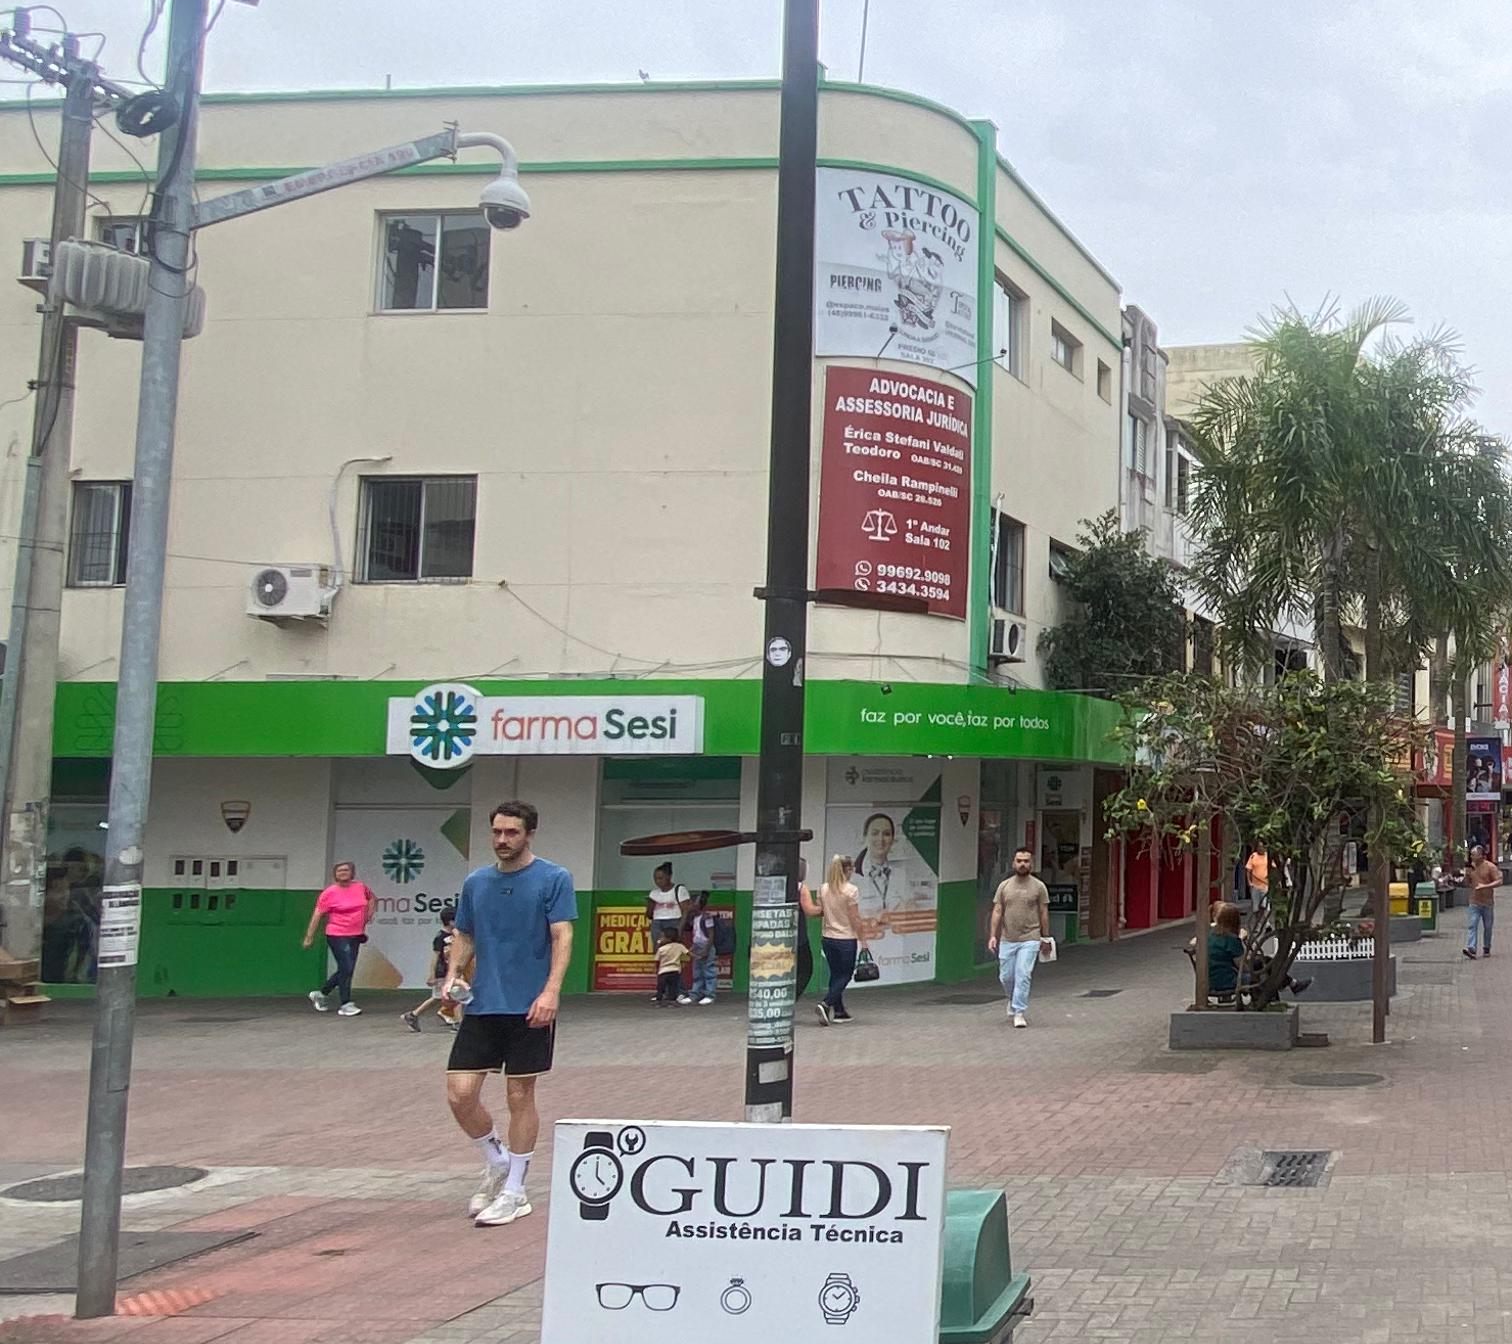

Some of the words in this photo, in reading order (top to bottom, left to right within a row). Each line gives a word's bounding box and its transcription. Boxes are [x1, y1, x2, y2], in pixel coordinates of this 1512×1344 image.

[838, 184, 971, 244] TATTOO
[859, 211, 877, 231] &
[885, 211, 966, 263] Piercing
[830, 274, 882, 293] PIERCING
[870, 377, 946, 410] ADVOCACIA
[947, 395, 955, 410] E
[835, 395, 924, 424] ASSESSORIA
[926, 410, 968, 439] JURÍDICA
[844, 424, 882, 442] Érica
[885, 431, 930, 451] Stefani
[843, 442, 901, 460] Teodoro
[853, 469, 898, 486] Cheila
[900, 475, 959, 498] Rampinelli
[920, 520, 950, 537] Andar
[904, 532, 931, 548] Sala
[933, 535, 951, 551] 102
[876, 580, 950, 601] 3434.3594
[859, 707, 886, 724] faz
[893, 711, 922, 727] por
[993, 716, 1016, 731] por
[1019, 715, 1050, 731] todos
[629, 1154, 930, 1222] GUIDI
[665, 1220, 802, 1242] Assistência
[809, 1223, 904, 1244] Técnica
